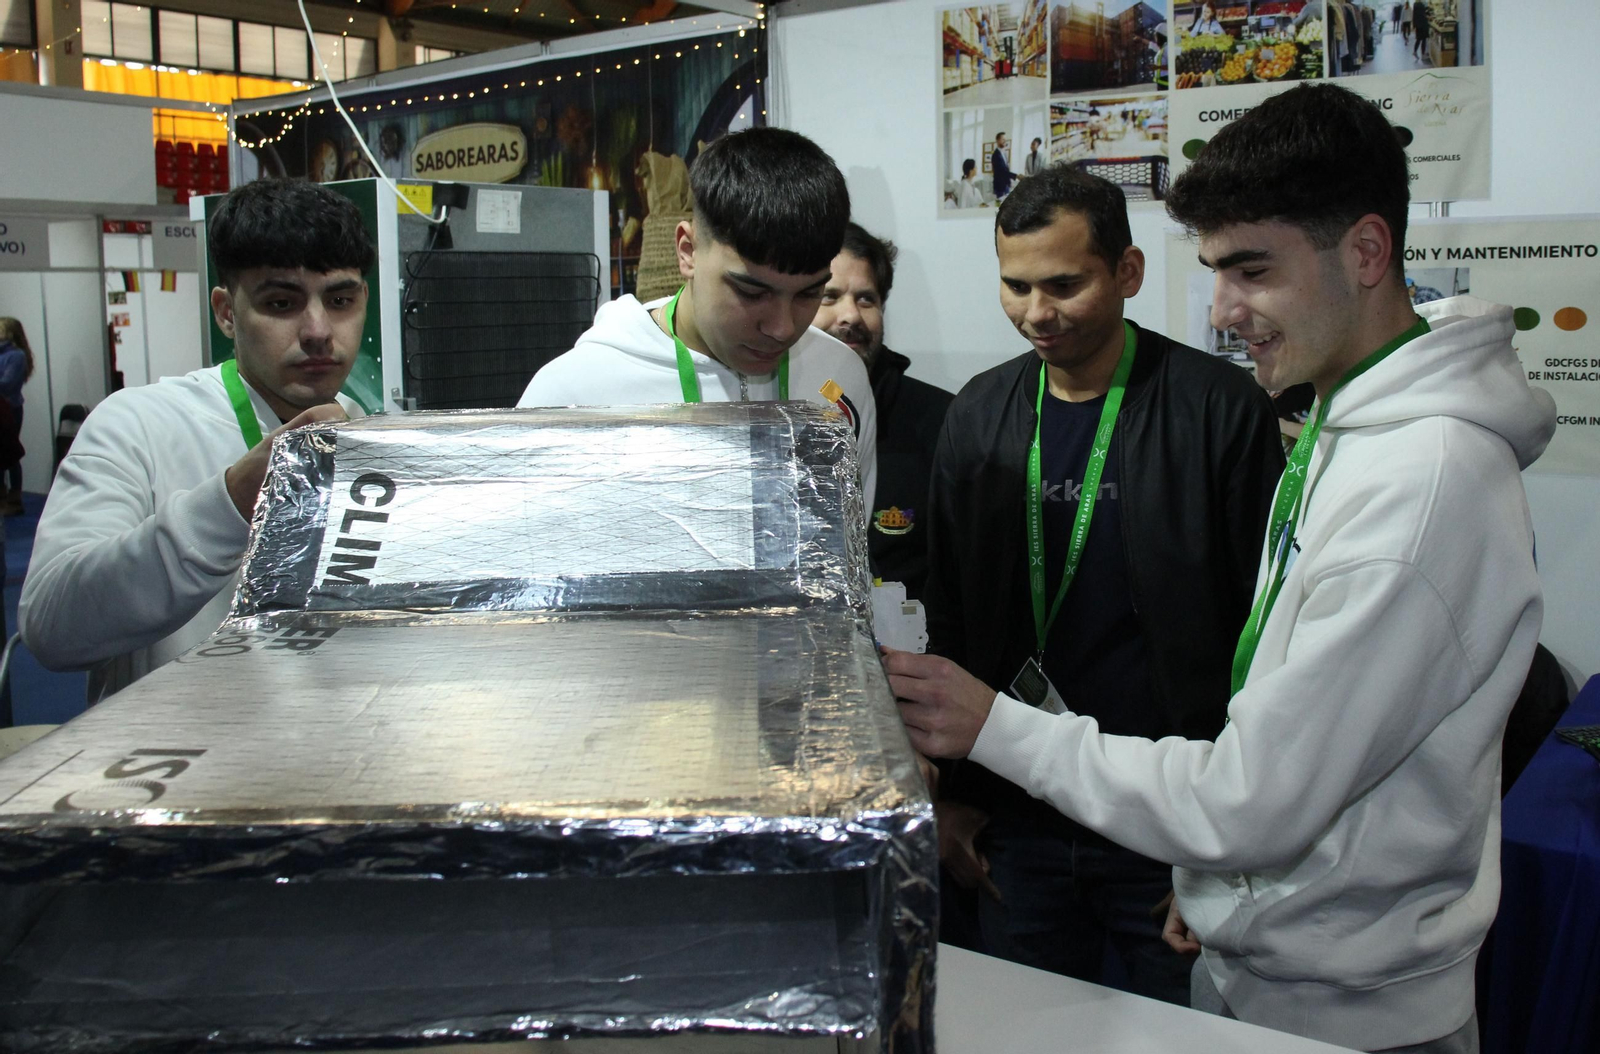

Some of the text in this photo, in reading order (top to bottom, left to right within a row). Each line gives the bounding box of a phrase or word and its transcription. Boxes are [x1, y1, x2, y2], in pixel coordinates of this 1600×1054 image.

[415, 141, 519, 173] SABOREARAS
[1413, 154, 1461, 163] COMERCIALES
[1431, 247, 1442, 260] Y
[1447, 244, 1598, 260] MANTENIMIENTO
[1545, 358, 1588, 368] GDCFGS
[1528, 371, 1600, 381] DE INSTALACI
[1556, 415, 1587, 425] CFGM
[1083, 493, 1092, 512] ARAS
[1032, 504, 1037, 513] DE
[1080, 514, 1087, 523] DE
[322, 472, 397, 587] CLIM
[1074, 525, 1085, 549] SIERRA
